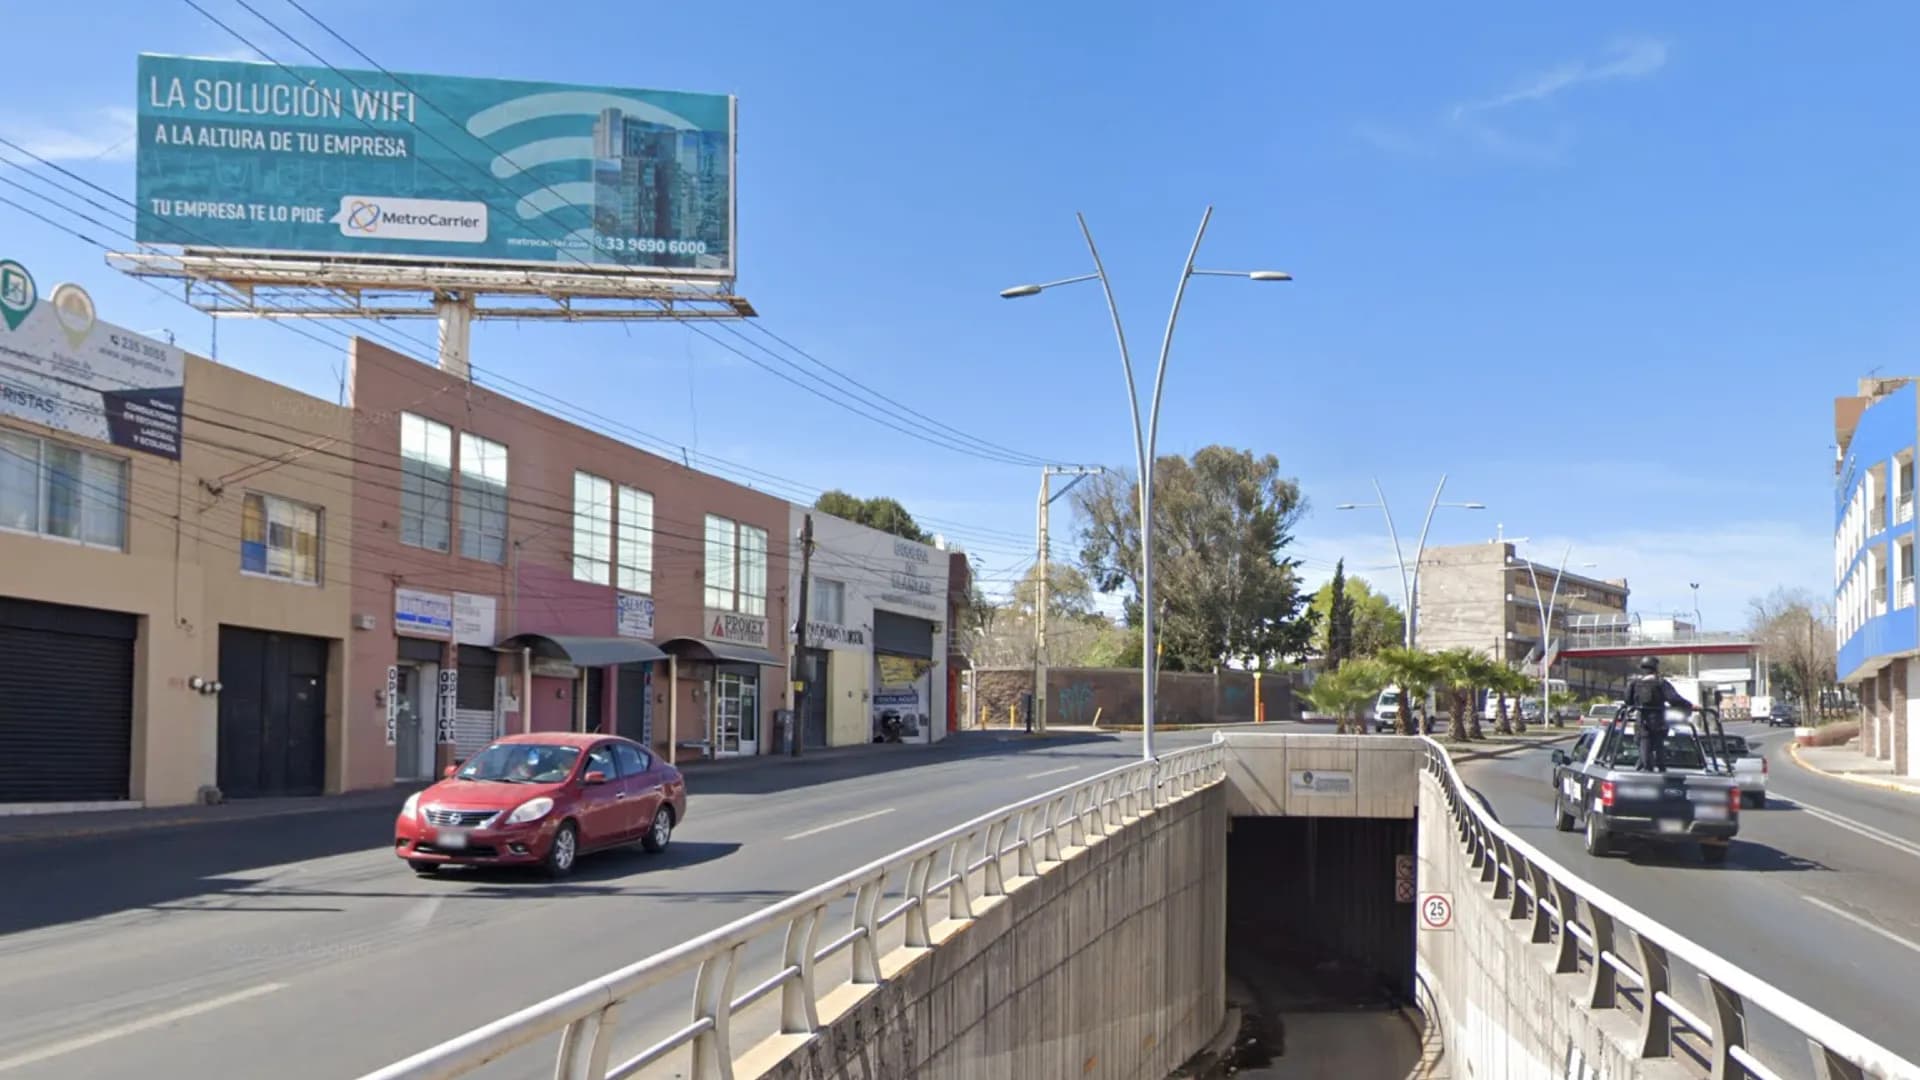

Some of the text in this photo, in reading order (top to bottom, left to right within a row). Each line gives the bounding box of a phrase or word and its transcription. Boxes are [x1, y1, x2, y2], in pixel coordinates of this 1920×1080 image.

[151, 76, 416, 123] LA SOLUCIÓN WIFI
[155, 123, 408, 158] A LA ALTURA DE TU EMPRESA
[151, 198, 326, 224] TU EMPRESA TE LO PIDE
[382, 212, 480, 228] MetroCarrier
[606, 237, 625, 251] 33
[669, 240, 706, 255] 6000
[440, 671, 449, 741] OPTICA
[1430, 901, 1444, 916] 25
